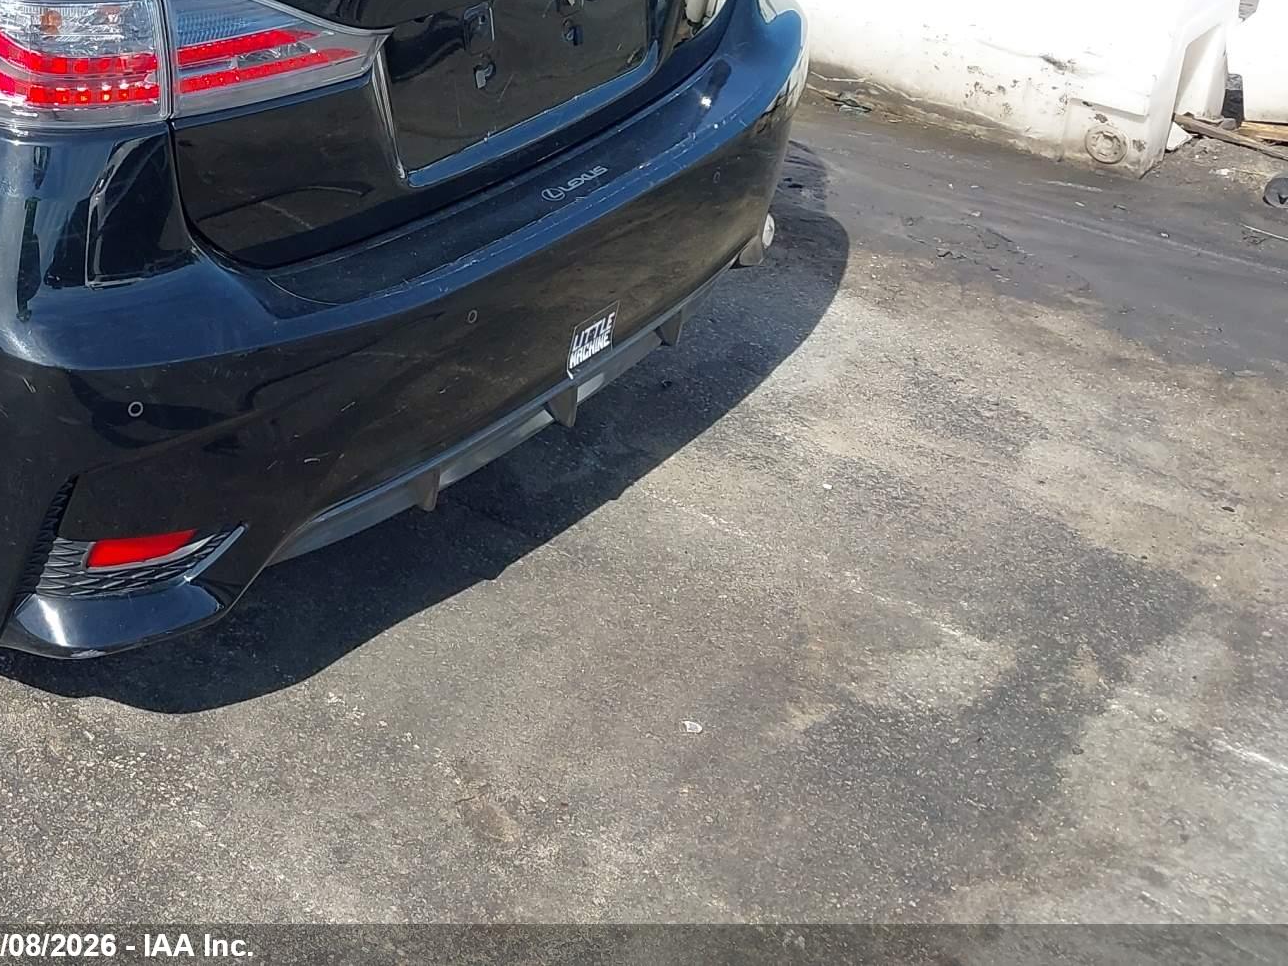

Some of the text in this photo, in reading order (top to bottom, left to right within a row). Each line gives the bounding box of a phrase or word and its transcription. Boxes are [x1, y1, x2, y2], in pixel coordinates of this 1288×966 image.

[558, 165, 608, 191] LEXUS
[569, 329, 611, 369] MACHINE
[572, 311, 616, 352] LITTLE
